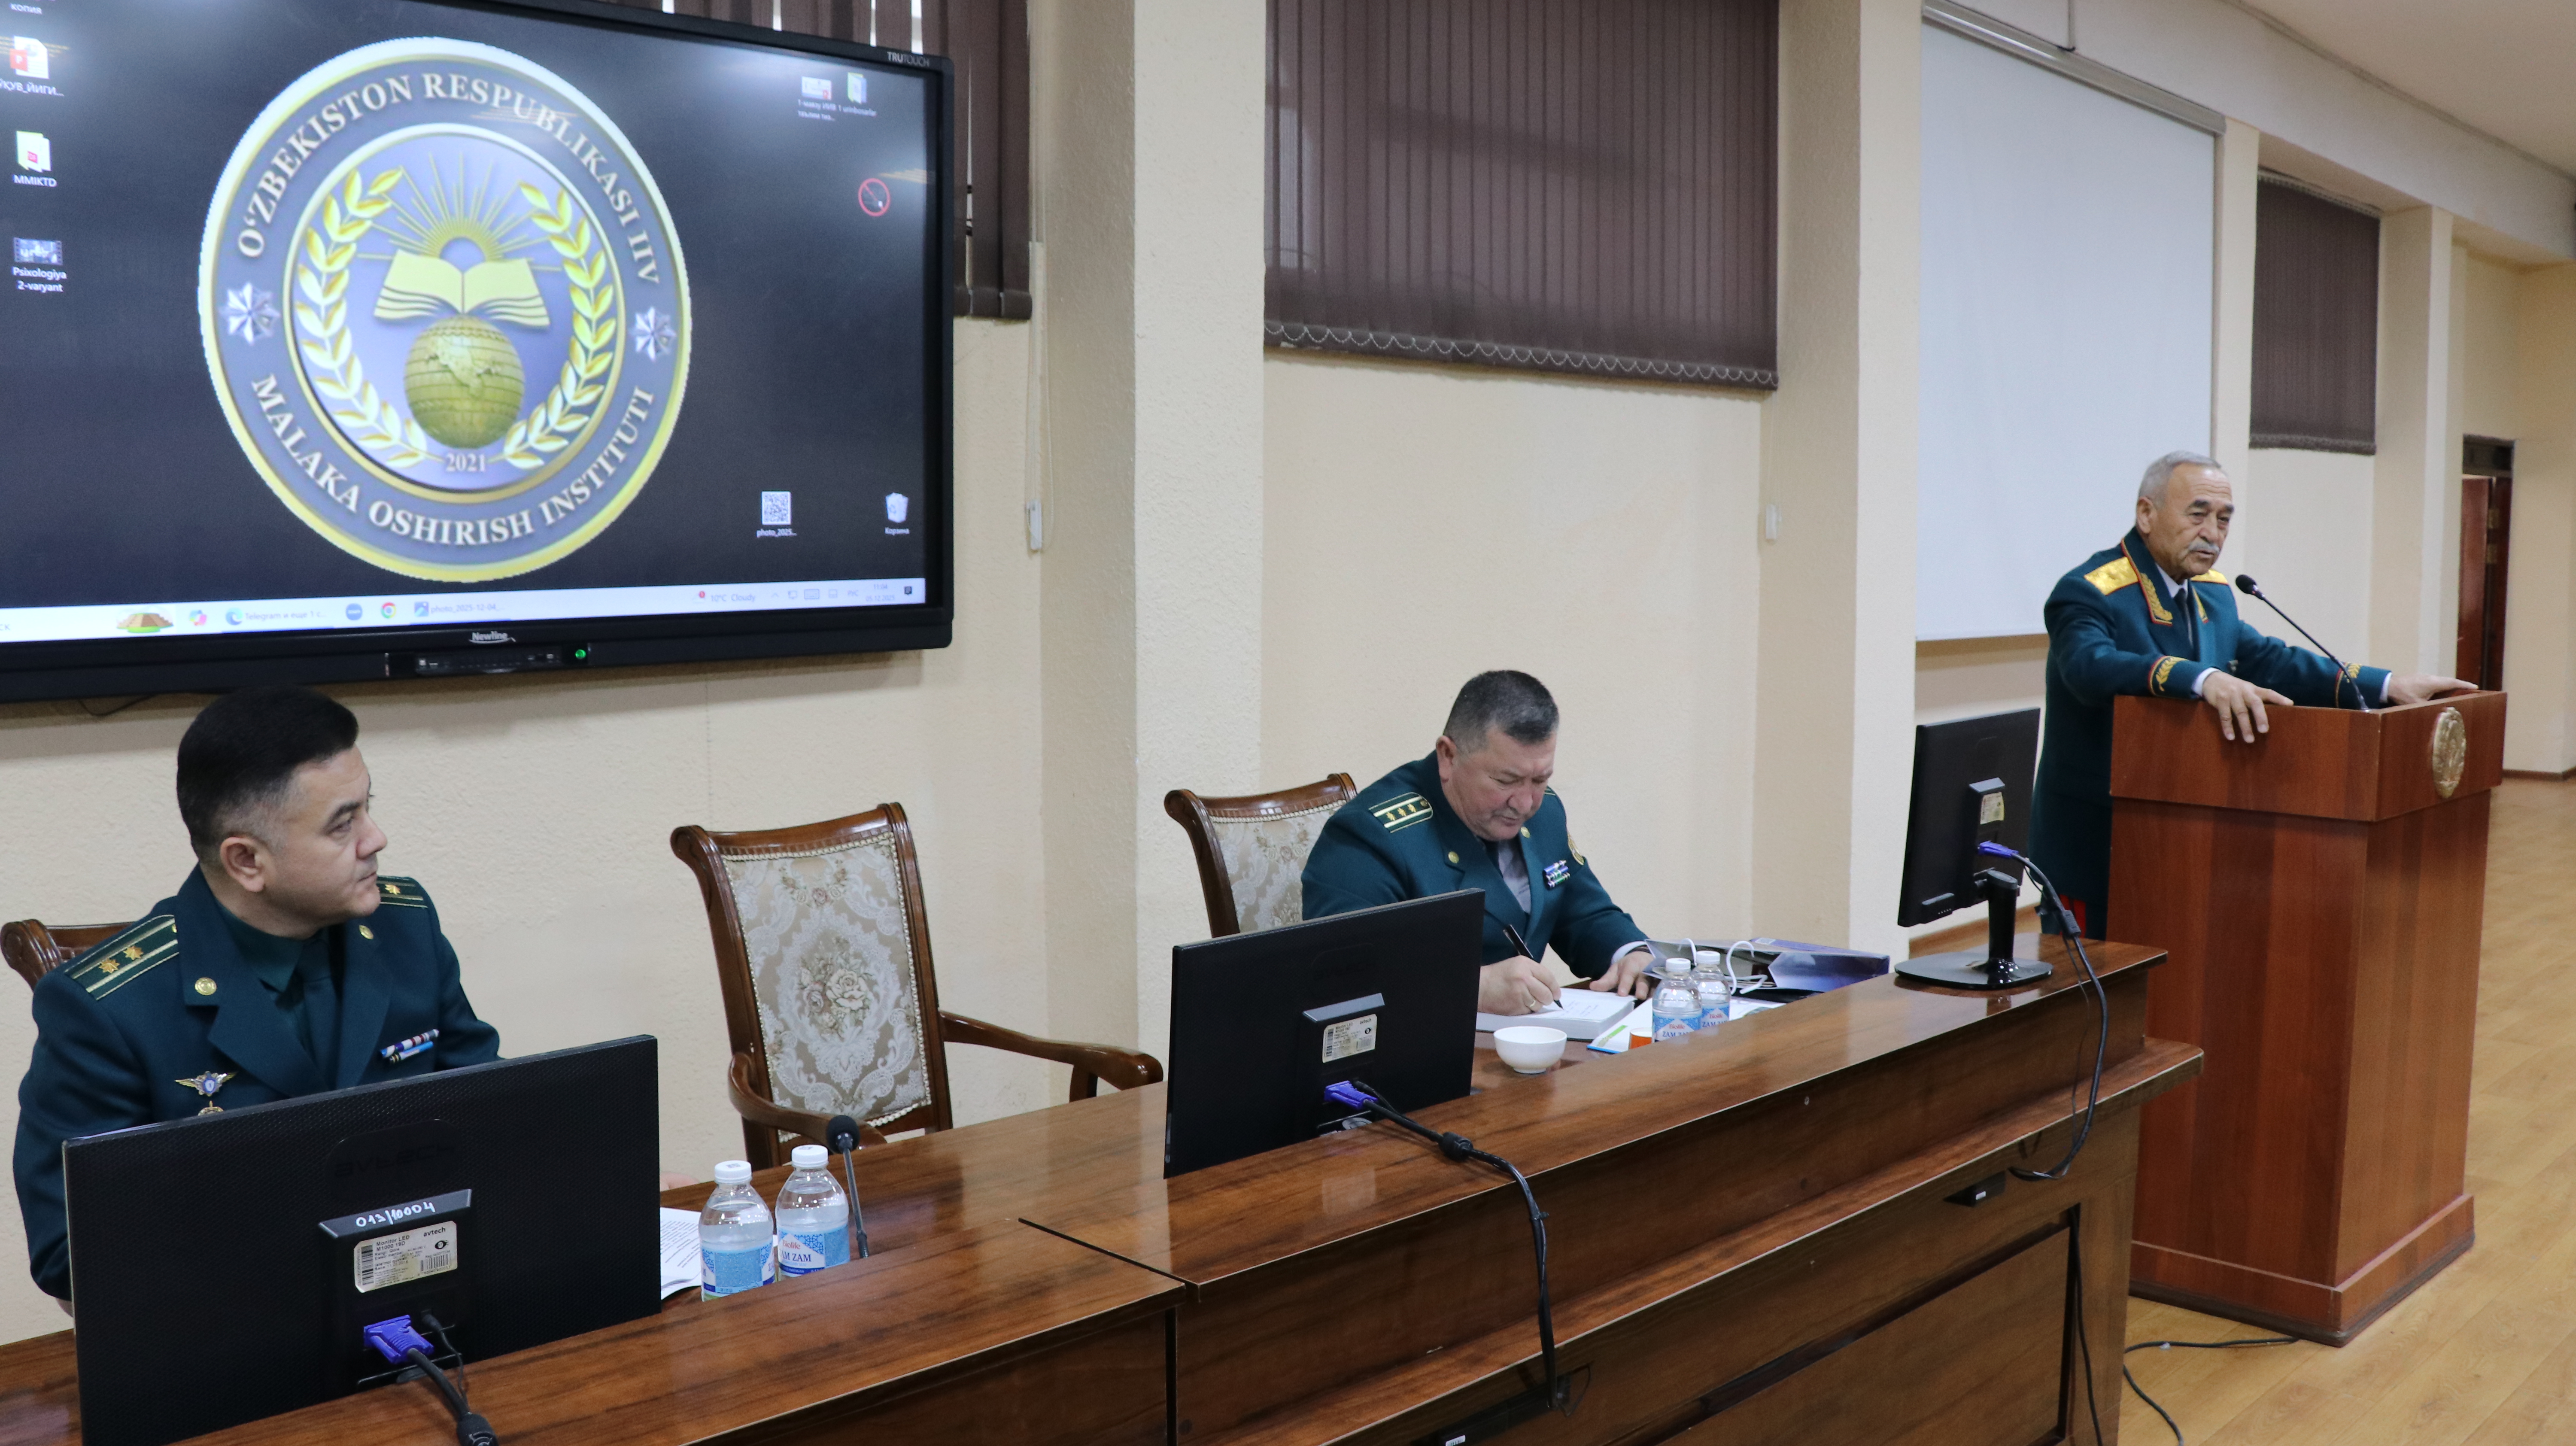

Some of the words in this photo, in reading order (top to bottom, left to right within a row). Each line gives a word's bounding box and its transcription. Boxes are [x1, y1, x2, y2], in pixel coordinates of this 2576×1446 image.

[9, 3, 42, 15] копия
[887, 51, 929, 67] TRUTOUCH
[12, 174, 57, 187] MMIKTD
[422, 73, 641, 228] RESPUBLIKASI
[627, 231, 660, 284] IIV
[12, 266, 67, 280] Psixologiya
[17, 280, 64, 293] 2-varyant
[251, 373, 360, 513] MALAKA
[368, 501, 535, 546] OSHIRISH
[538, 386, 654, 526] INSTITUTI
[446, 453, 486, 472] 2021
[884, 526, 910, 536] Корзина
[731, 594, 756, 602] Cloudy
[245, 612, 281, 621] Telegram
[472, 631, 508, 641] Newline
[423, 1227, 446, 1236] avtech
[782, 1239, 801, 1249] Biolife
[792, 1253, 811, 1262] ZAM
